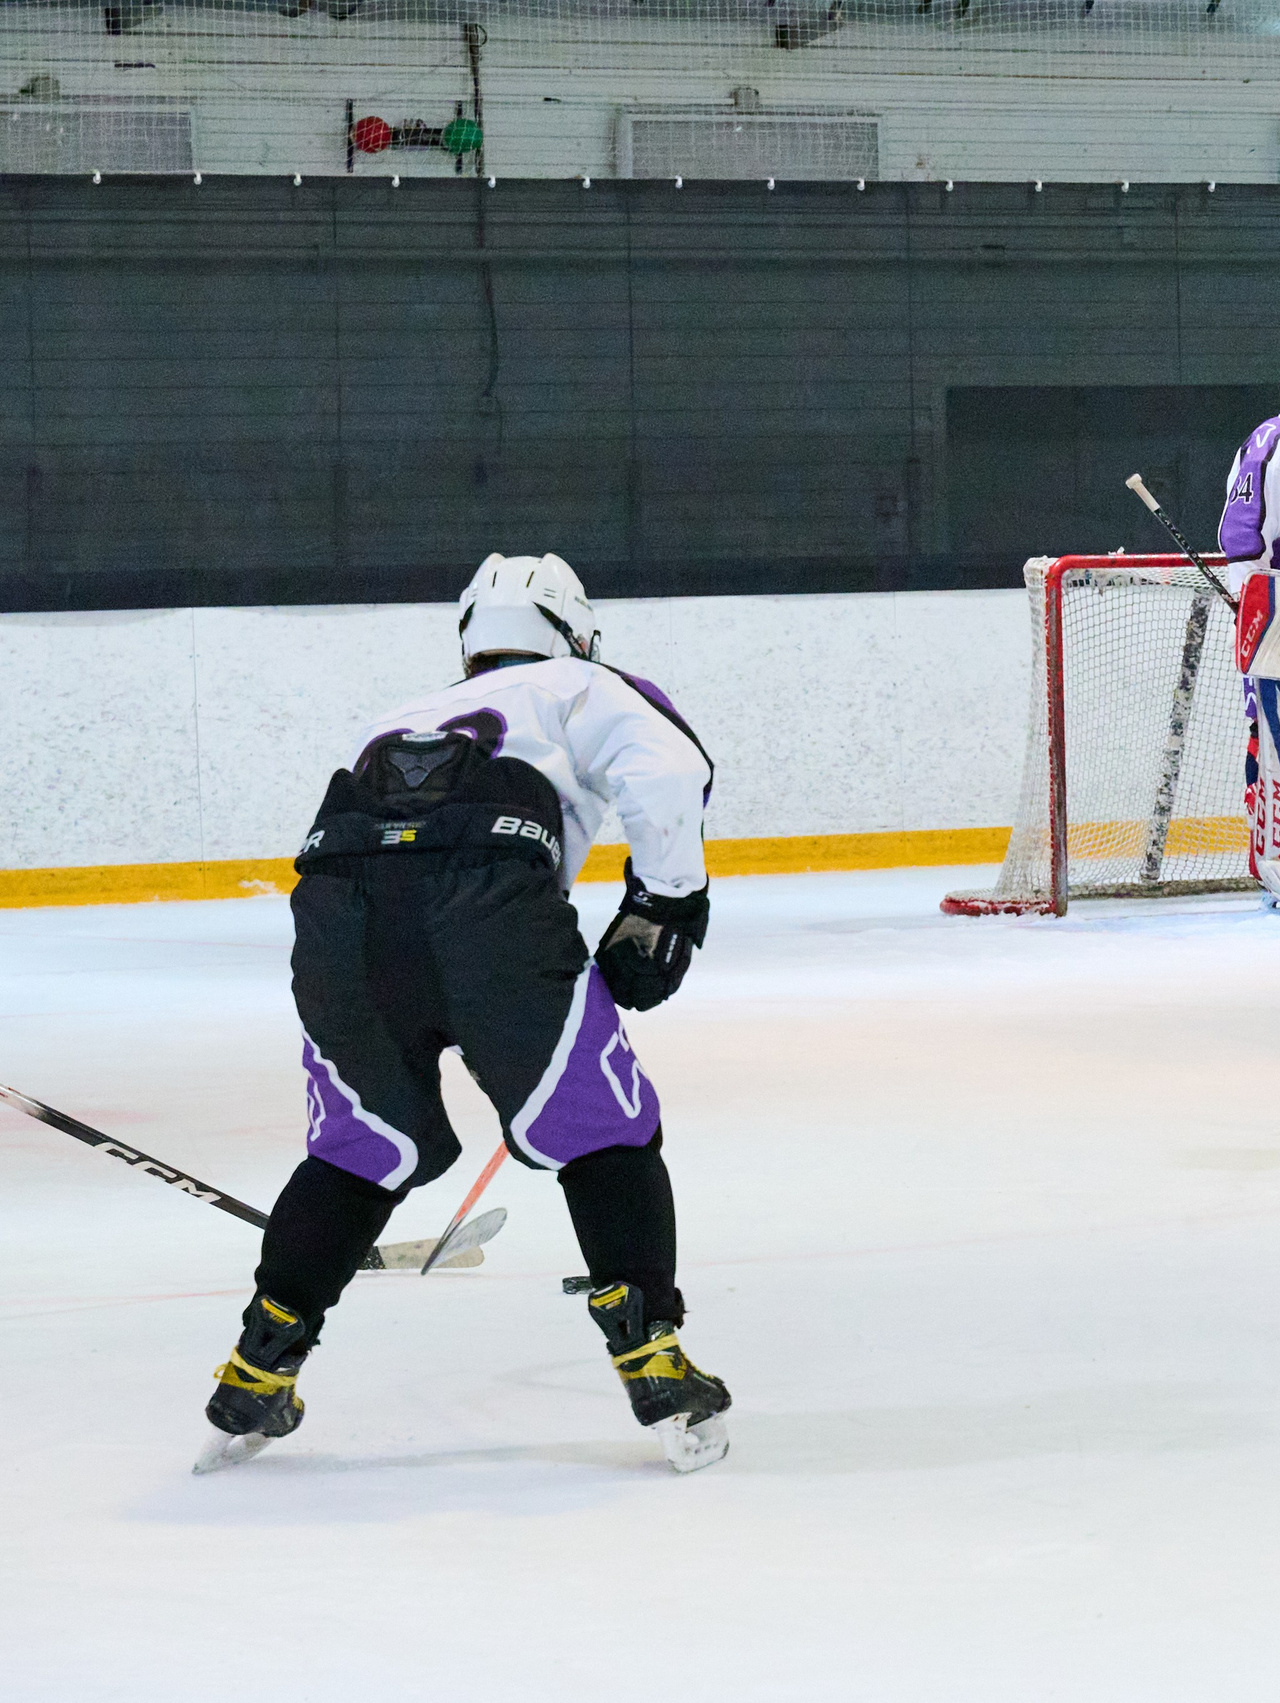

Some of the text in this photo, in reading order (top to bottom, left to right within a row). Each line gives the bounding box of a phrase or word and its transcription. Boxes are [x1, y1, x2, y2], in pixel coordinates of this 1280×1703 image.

[1241, 609, 1263, 657] CCM
[1256, 776, 1267, 857] CCM
[93, 1141, 222, 1204] CCM
